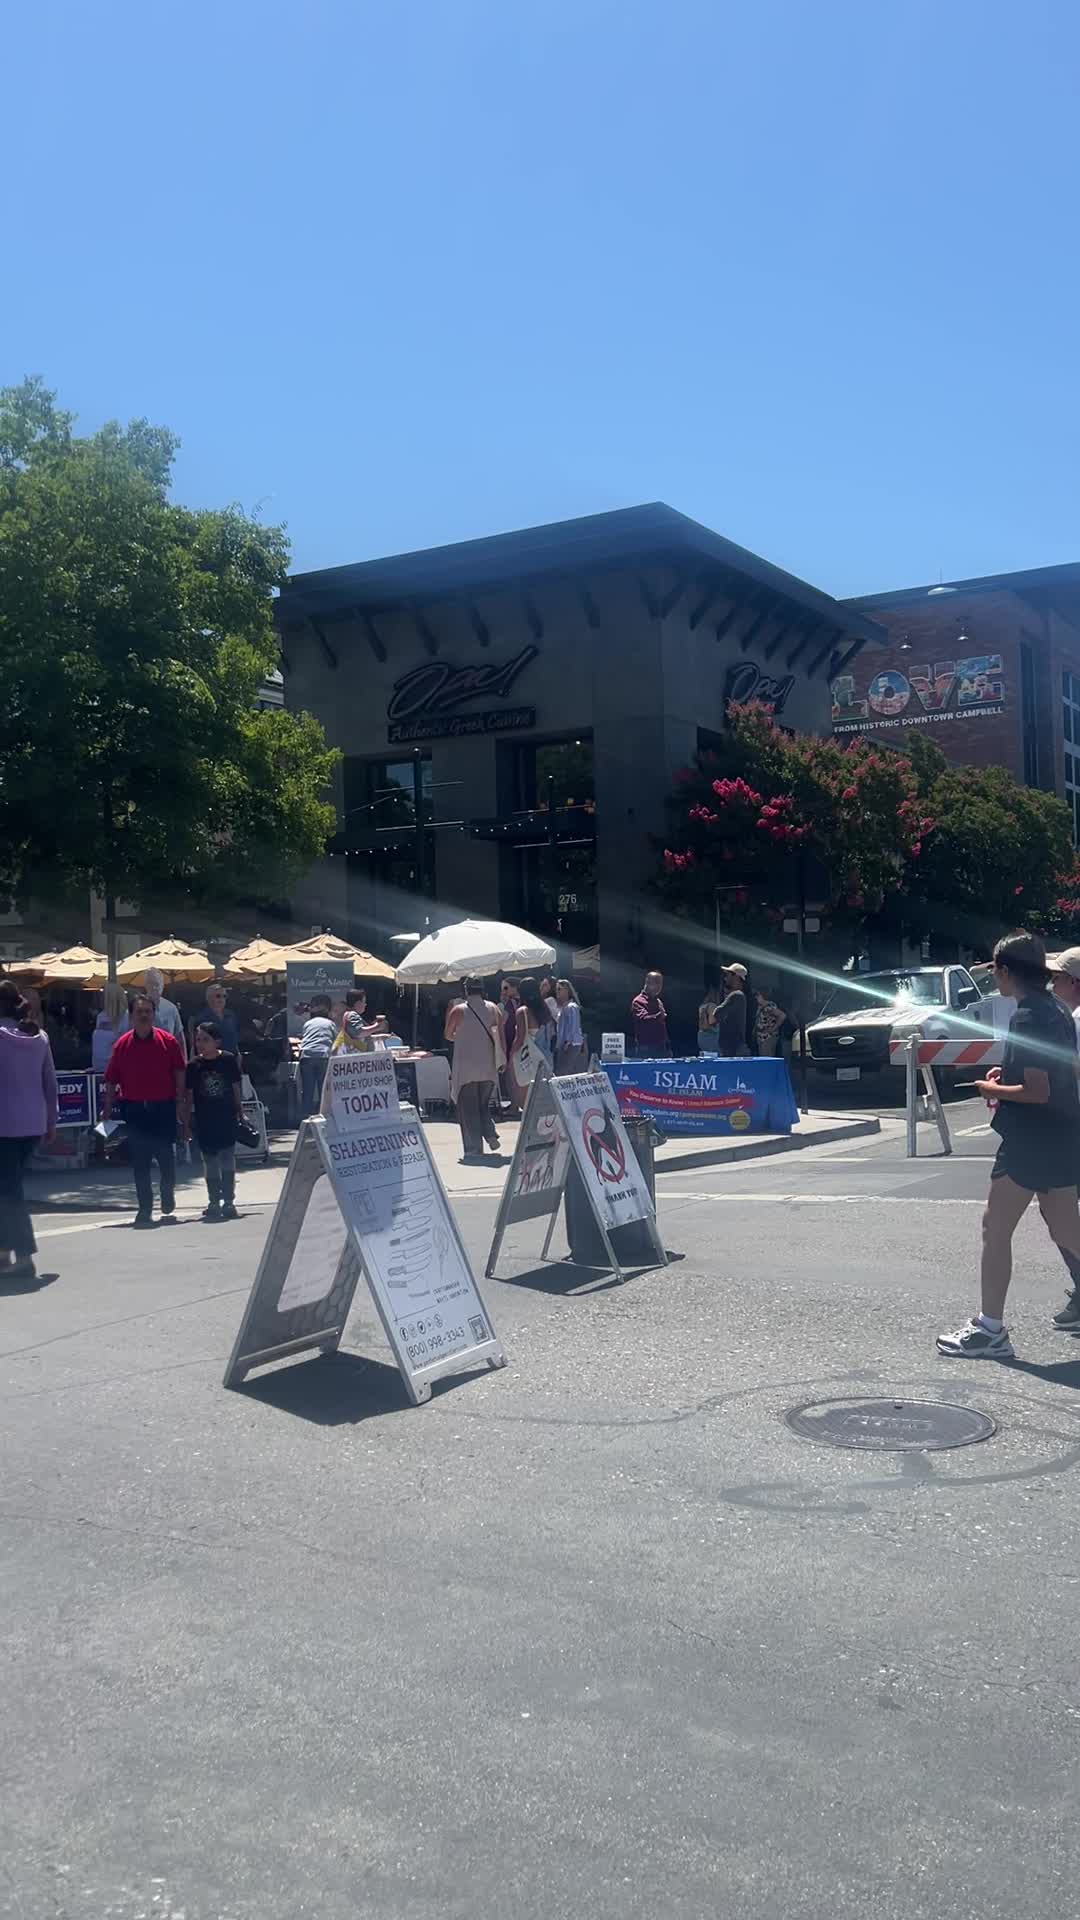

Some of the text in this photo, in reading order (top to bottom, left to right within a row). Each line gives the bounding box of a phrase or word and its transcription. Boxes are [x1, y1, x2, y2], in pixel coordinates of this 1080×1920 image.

[832, 655, 1003, 721] LOVE
[449, 718, 486, 736] Greek
[488, 711, 532, 730] Cuisine
[834, 706, 1003, 733] FROM HISTORIC DOWNTOWN CAMPBELL
[559, 893, 577, 904] 276
[332, 1058, 392, 1077] SHARPENING
[333, 1075, 395, 1092] WHILE YOU SHOP
[654, 1071, 717, 1091] ISLAM
[341, 1092, 390, 1115] TODAY
[329, 1130, 419, 1160] SHARPENING
[337, 1160, 392, 1178] RESTORATION
[399, 1151, 426, 1166] REPAIR
[406, 1340, 429, 1363] (800)
[427, 1326, 465, 1351] 998-3343
